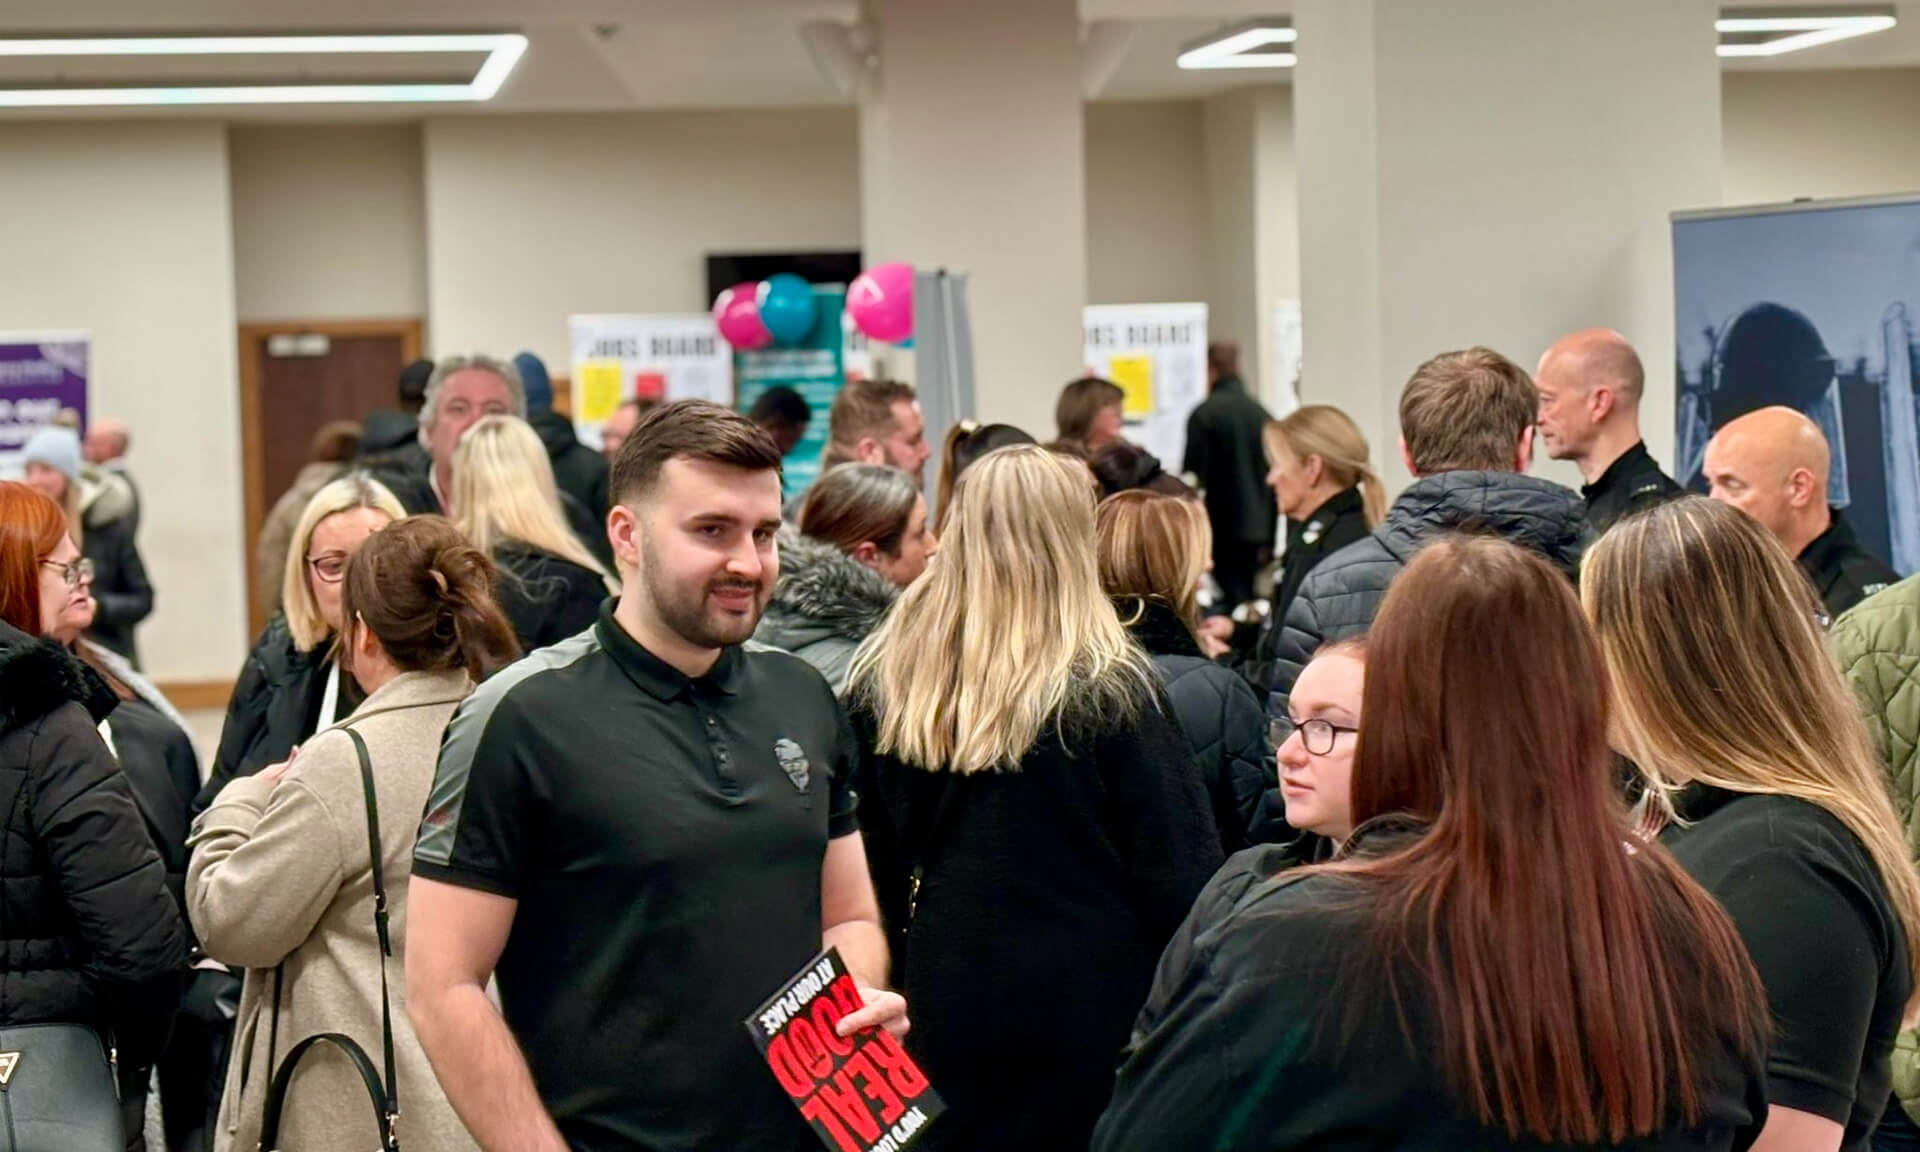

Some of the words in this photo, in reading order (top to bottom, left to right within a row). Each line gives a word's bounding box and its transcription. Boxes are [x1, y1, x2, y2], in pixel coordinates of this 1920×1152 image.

[791, 971, 822, 1005] OUR
[816, 958, 836, 986] AT
[760, 991, 801, 1035] PLACE
[800, 1027, 930, 1152] REAL
